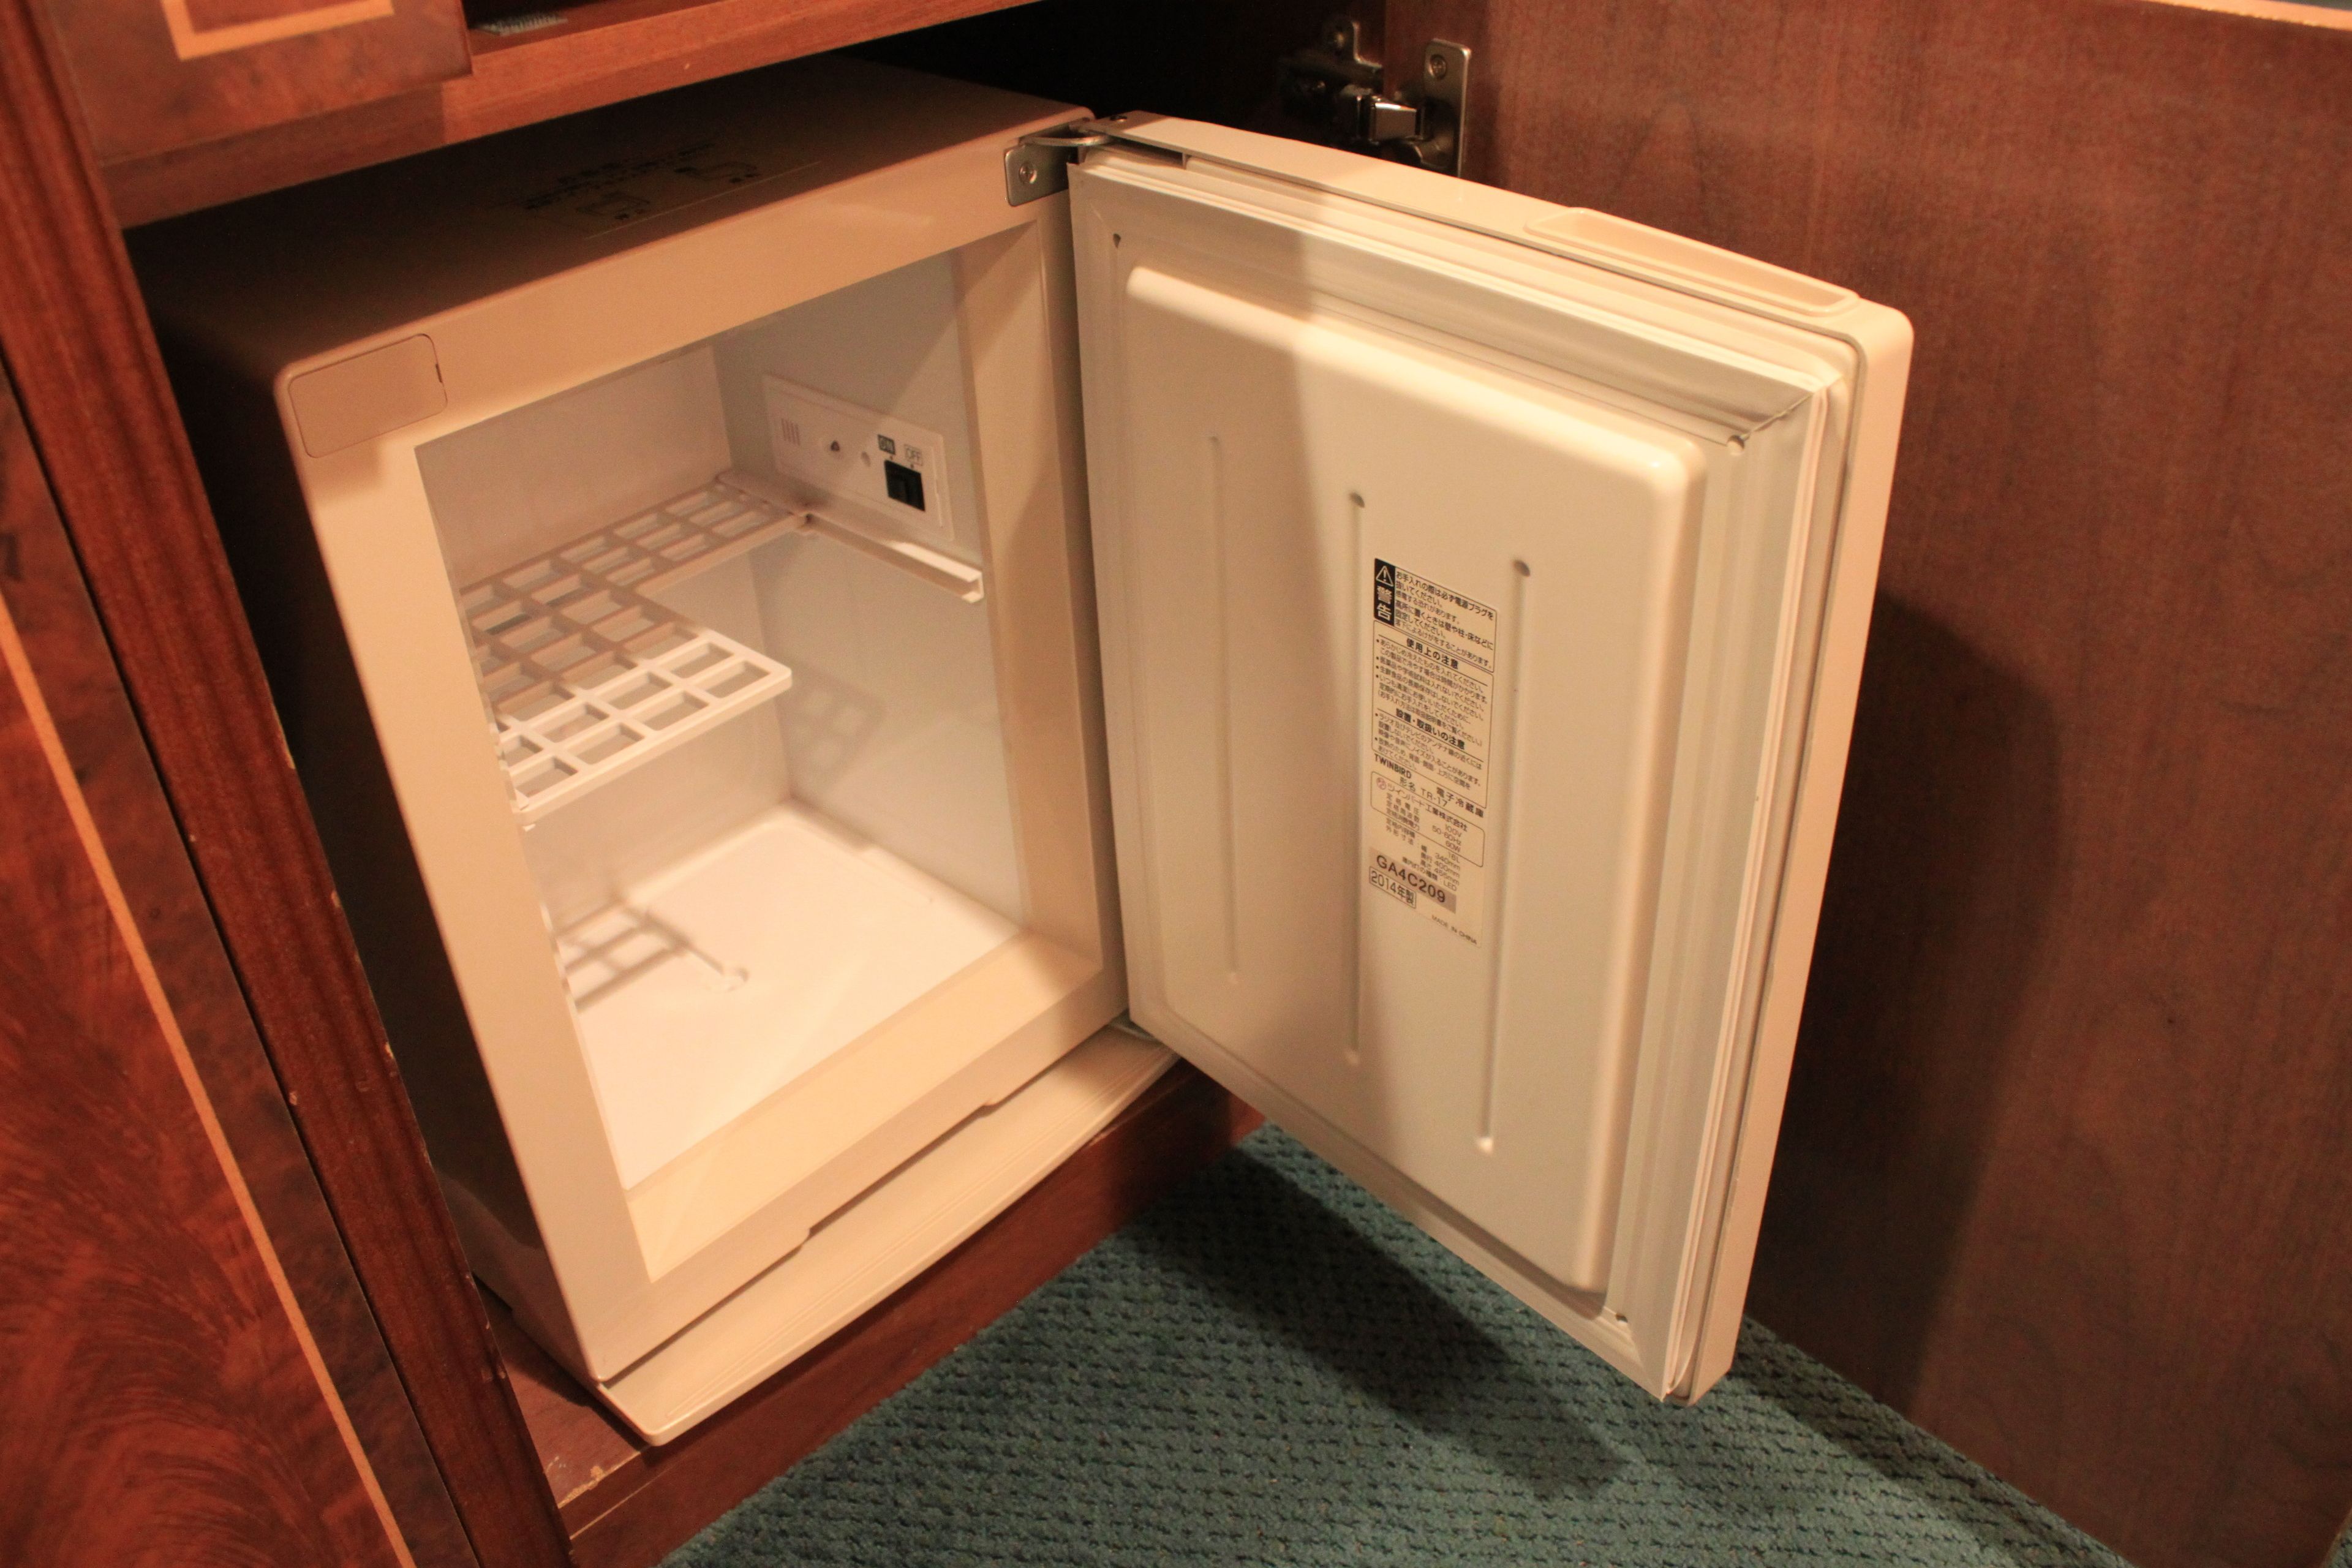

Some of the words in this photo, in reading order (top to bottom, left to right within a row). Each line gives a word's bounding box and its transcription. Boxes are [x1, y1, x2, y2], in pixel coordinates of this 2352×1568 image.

[1406, 637, 1458, 670] 使用上の注意
[1374, 753, 1411, 780] TWINBIRD
[1436, 786, 1484, 820] 電子冷蔵庫
[1371, 868, 1414, 907] 2014年製
[1376, 852, 1446, 905] GA4C209
